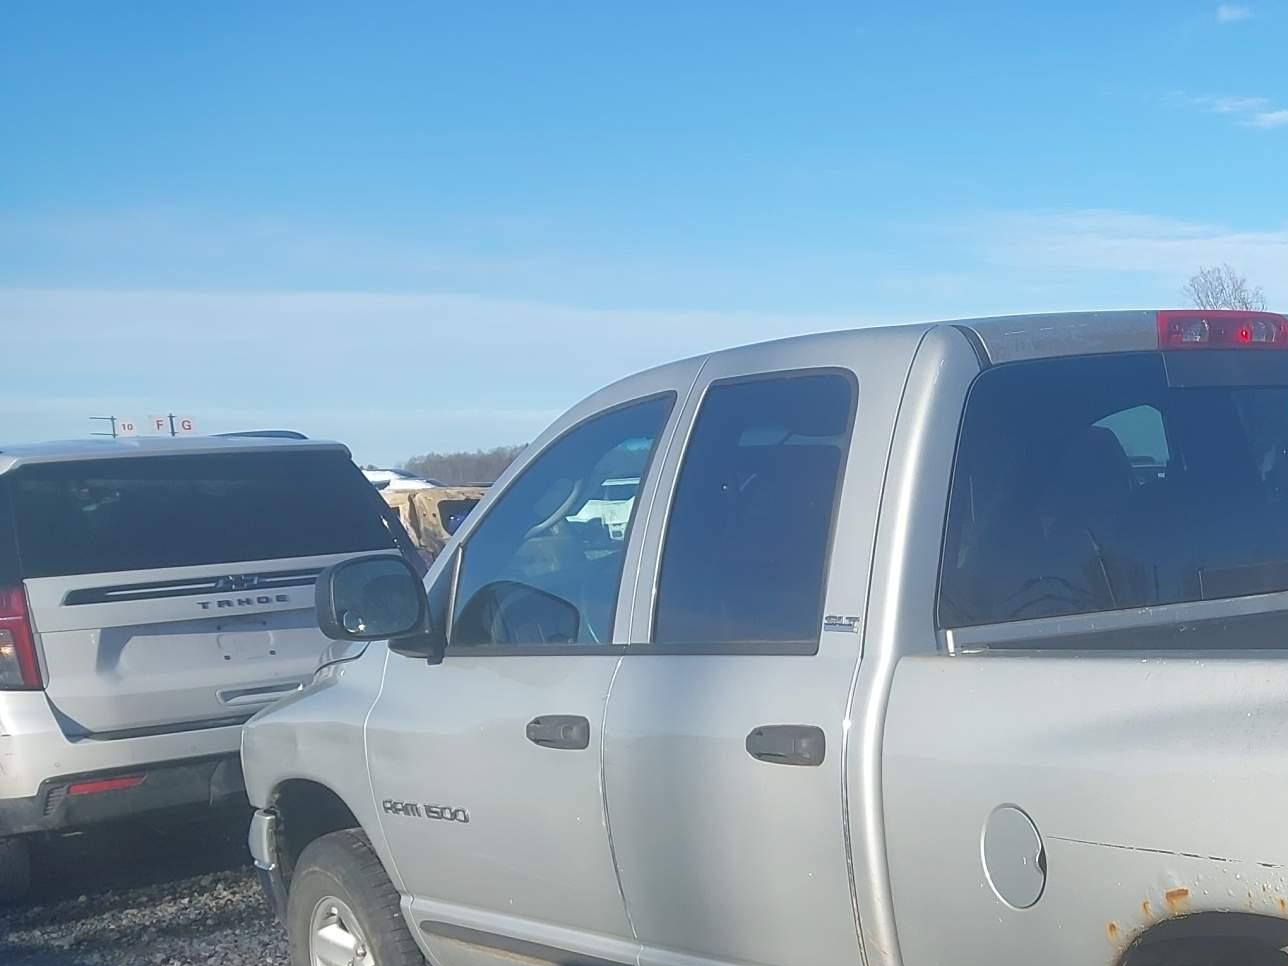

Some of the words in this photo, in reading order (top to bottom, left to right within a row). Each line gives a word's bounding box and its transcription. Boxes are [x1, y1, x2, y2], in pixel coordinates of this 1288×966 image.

[121, 423, 133, 431] 10
[156, 420, 164, 430] F
[181, 420, 192, 430] G
[196, 595, 288, 609] TAHOE
[382, 800, 422, 818] RAM
[423, 804, 469, 823] 1500
